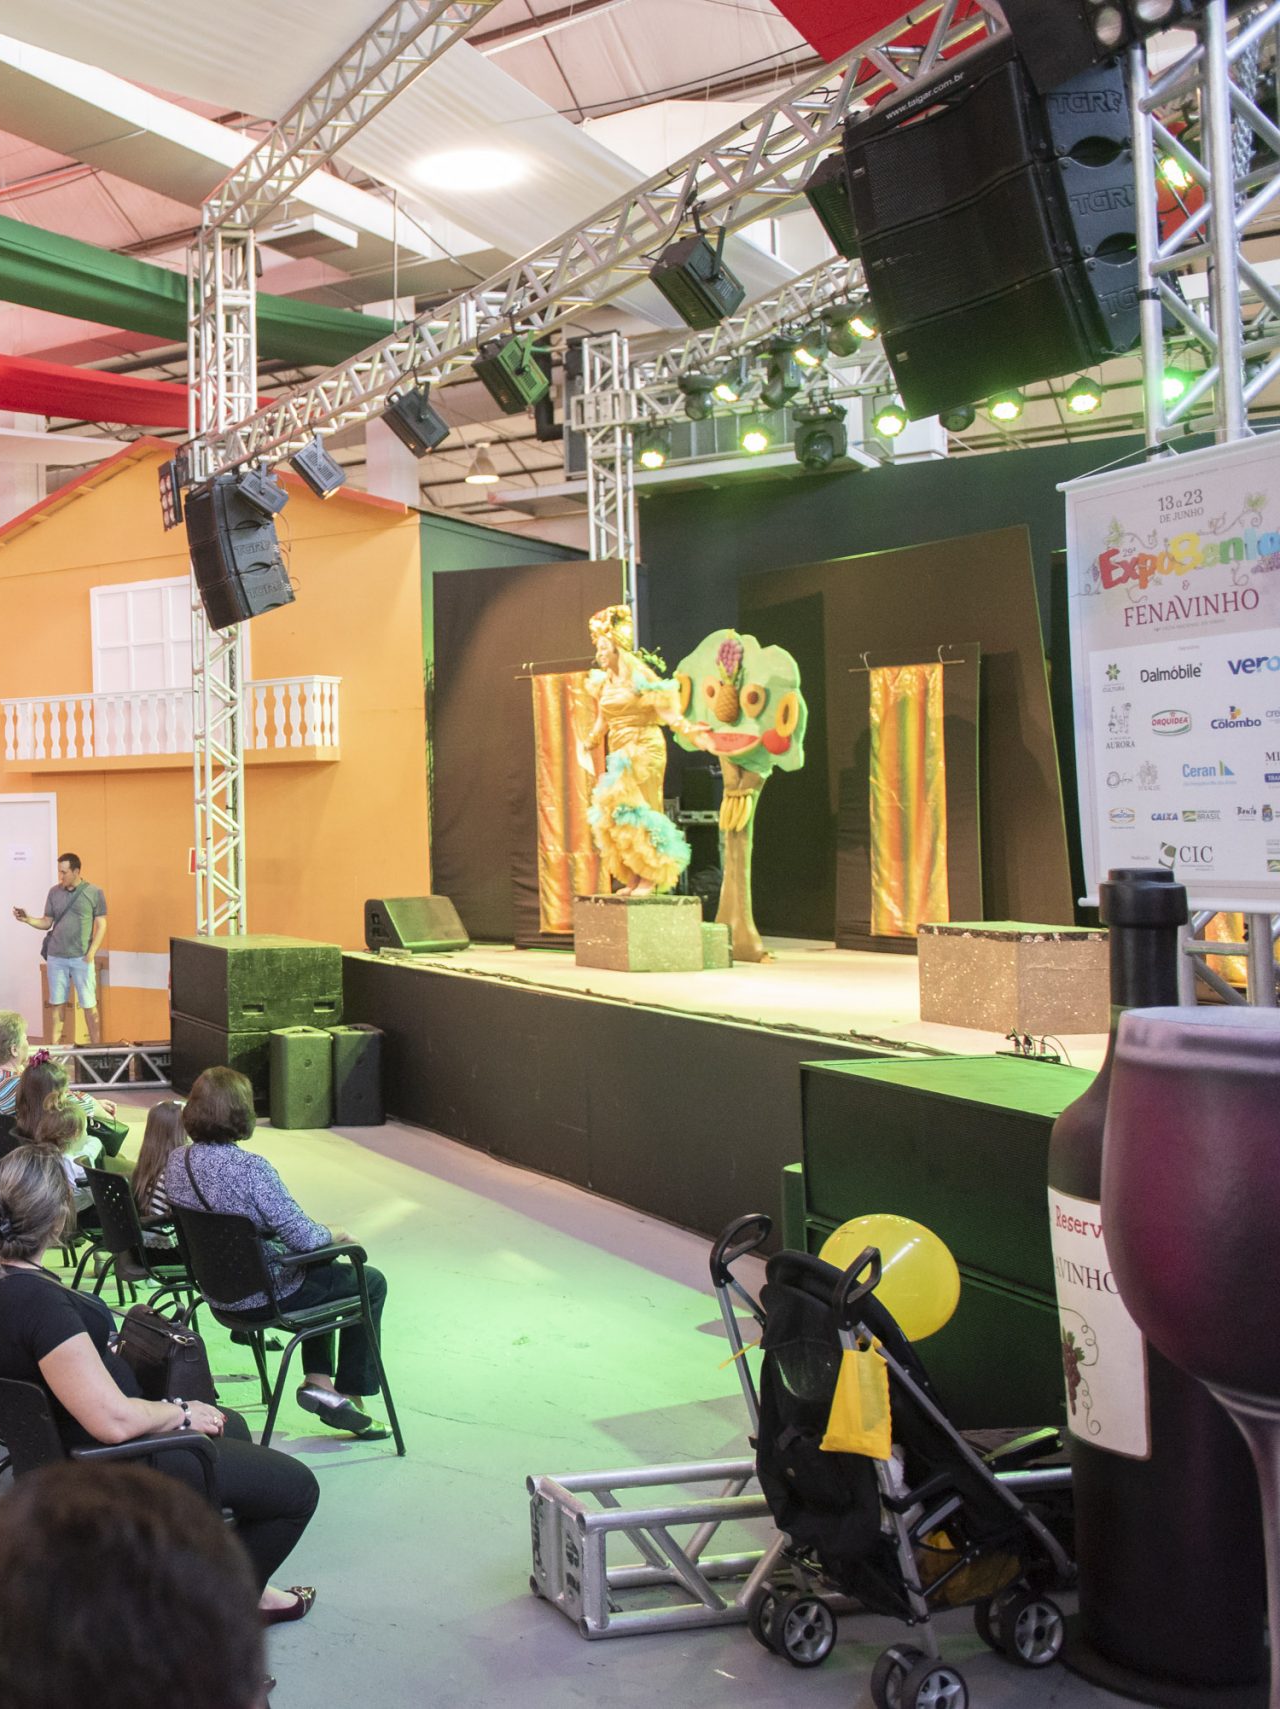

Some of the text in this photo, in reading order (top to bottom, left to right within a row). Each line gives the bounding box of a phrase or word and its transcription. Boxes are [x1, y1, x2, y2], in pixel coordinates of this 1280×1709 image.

[885, 71, 965, 119] www.taigar.com.br
[1158, 488, 1203, 511] 13 a 23
[1159, 507, 1204, 524] DE JUNHO
[1182, 579, 1190, 591] &
[1124, 588, 1260, 627] FENAVINHO
[1140, 663, 1201, 683] Dalmóbile
[1228, 655, 1280, 675] vero
[1210, 718, 1261, 730] Colombo
[1106, 741, 1135, 749] AURORA
[1182, 763, 1217, 778] Ceran
[1151, 812, 1179, 821] CAIXA
[1197, 813, 1221, 821] BRASIL
[1179, 846, 1214, 863] CIC
